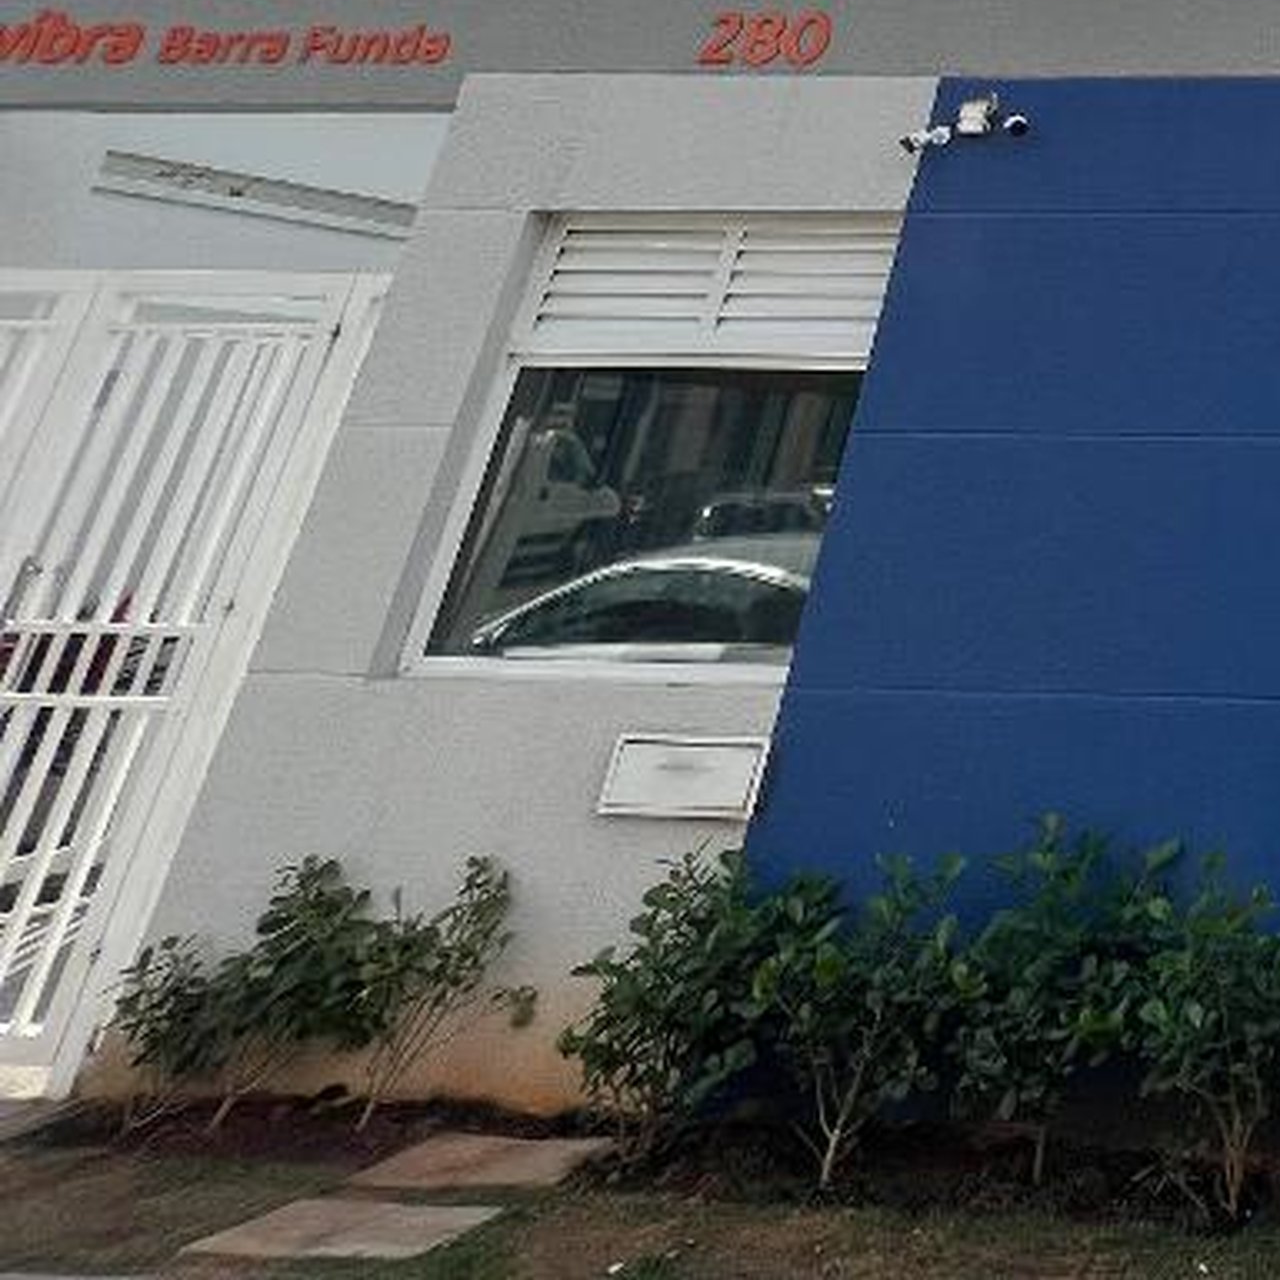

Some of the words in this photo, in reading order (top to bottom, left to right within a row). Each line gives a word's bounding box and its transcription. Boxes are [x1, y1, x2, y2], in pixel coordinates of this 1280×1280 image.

[158, 25, 290, 63] Barra
[300, 23, 451, 63] Funda
[695, 10, 831, 67] 280
